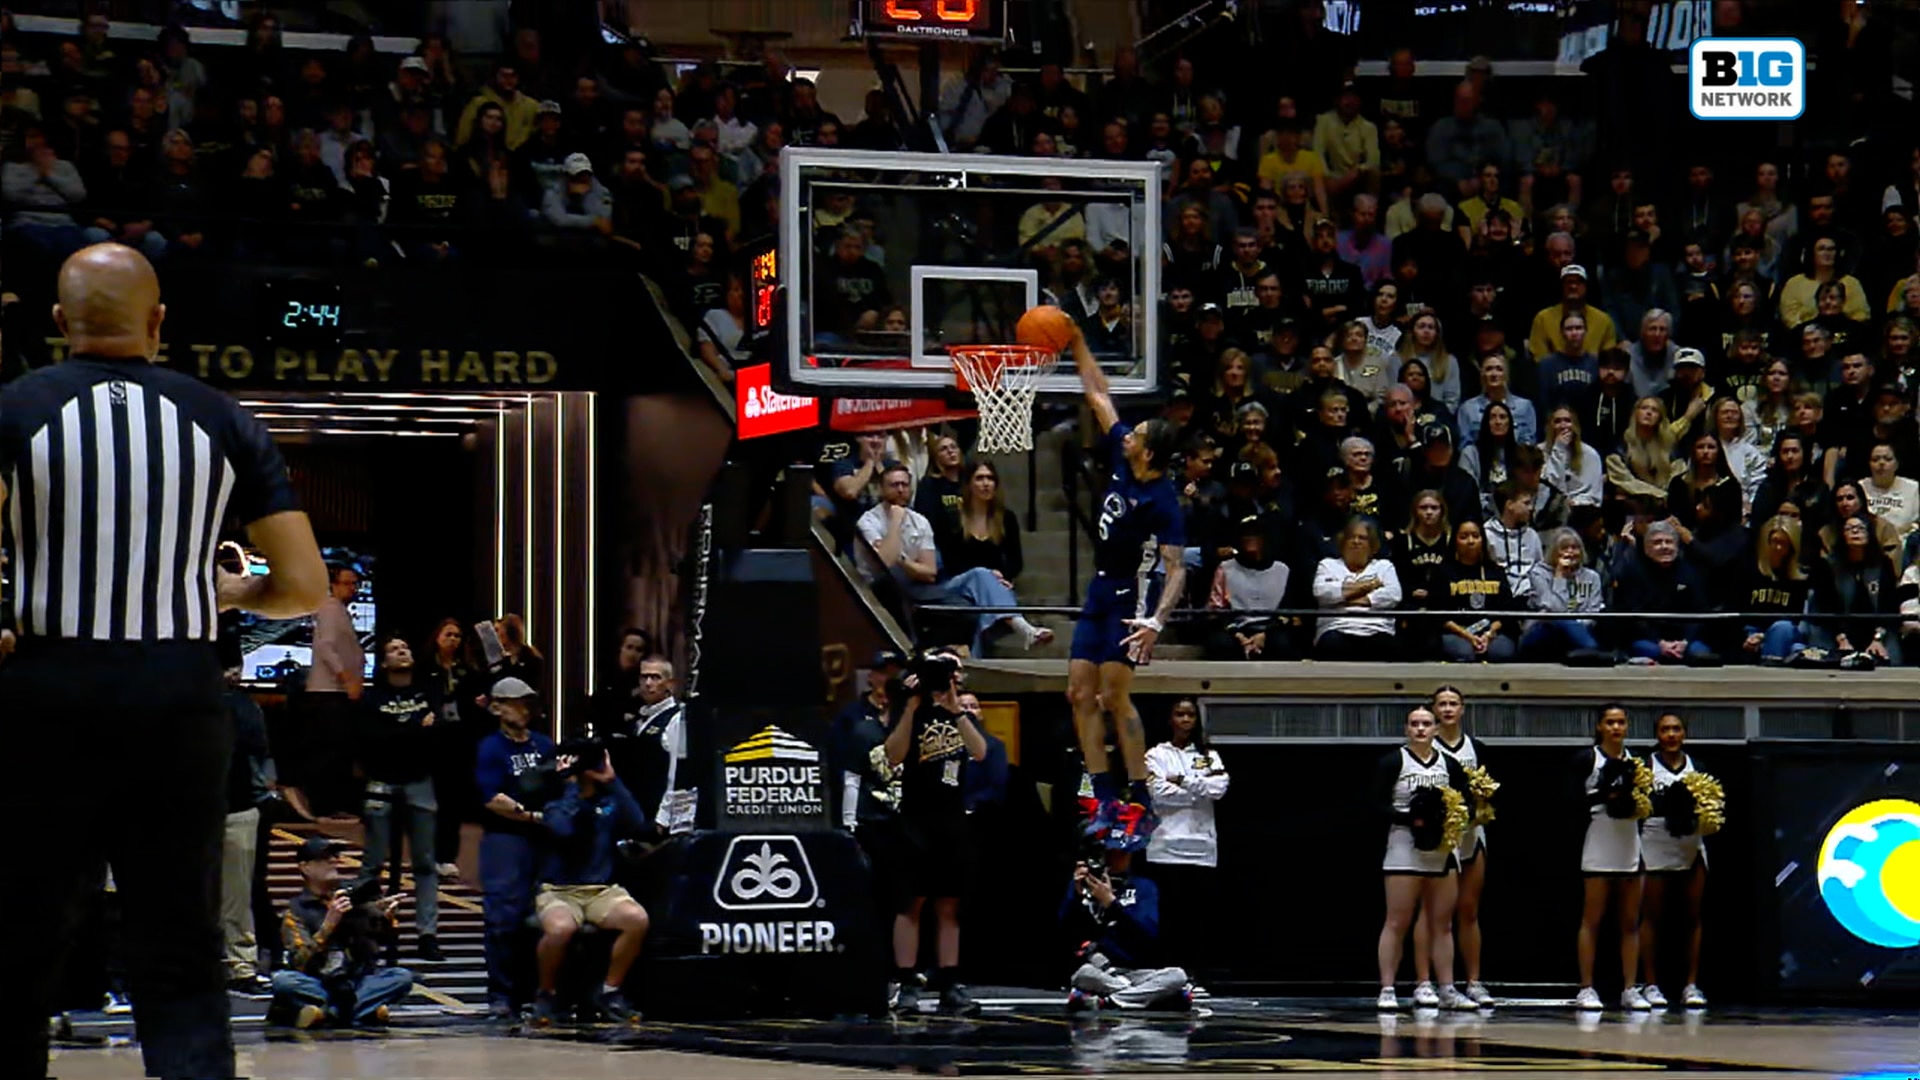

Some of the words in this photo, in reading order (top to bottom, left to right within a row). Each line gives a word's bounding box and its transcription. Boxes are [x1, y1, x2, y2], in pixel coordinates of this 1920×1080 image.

[896, 24, 969, 36] DAKTRONICS
[283, 301, 341, 328] 2:44
[190, 344, 255, 379] TO
[272, 347, 400, 383] PLAY
[419, 348, 559, 385] HARD
[1099, 512, 1115, 541] 5
[725, 766, 821, 784] PURDUE
[726, 786, 822, 804] FEDERAL
[726, 804, 774, 815] CREDIT
[778, 804, 822, 815] UNION
[699, 920, 836, 954] PIONEER
